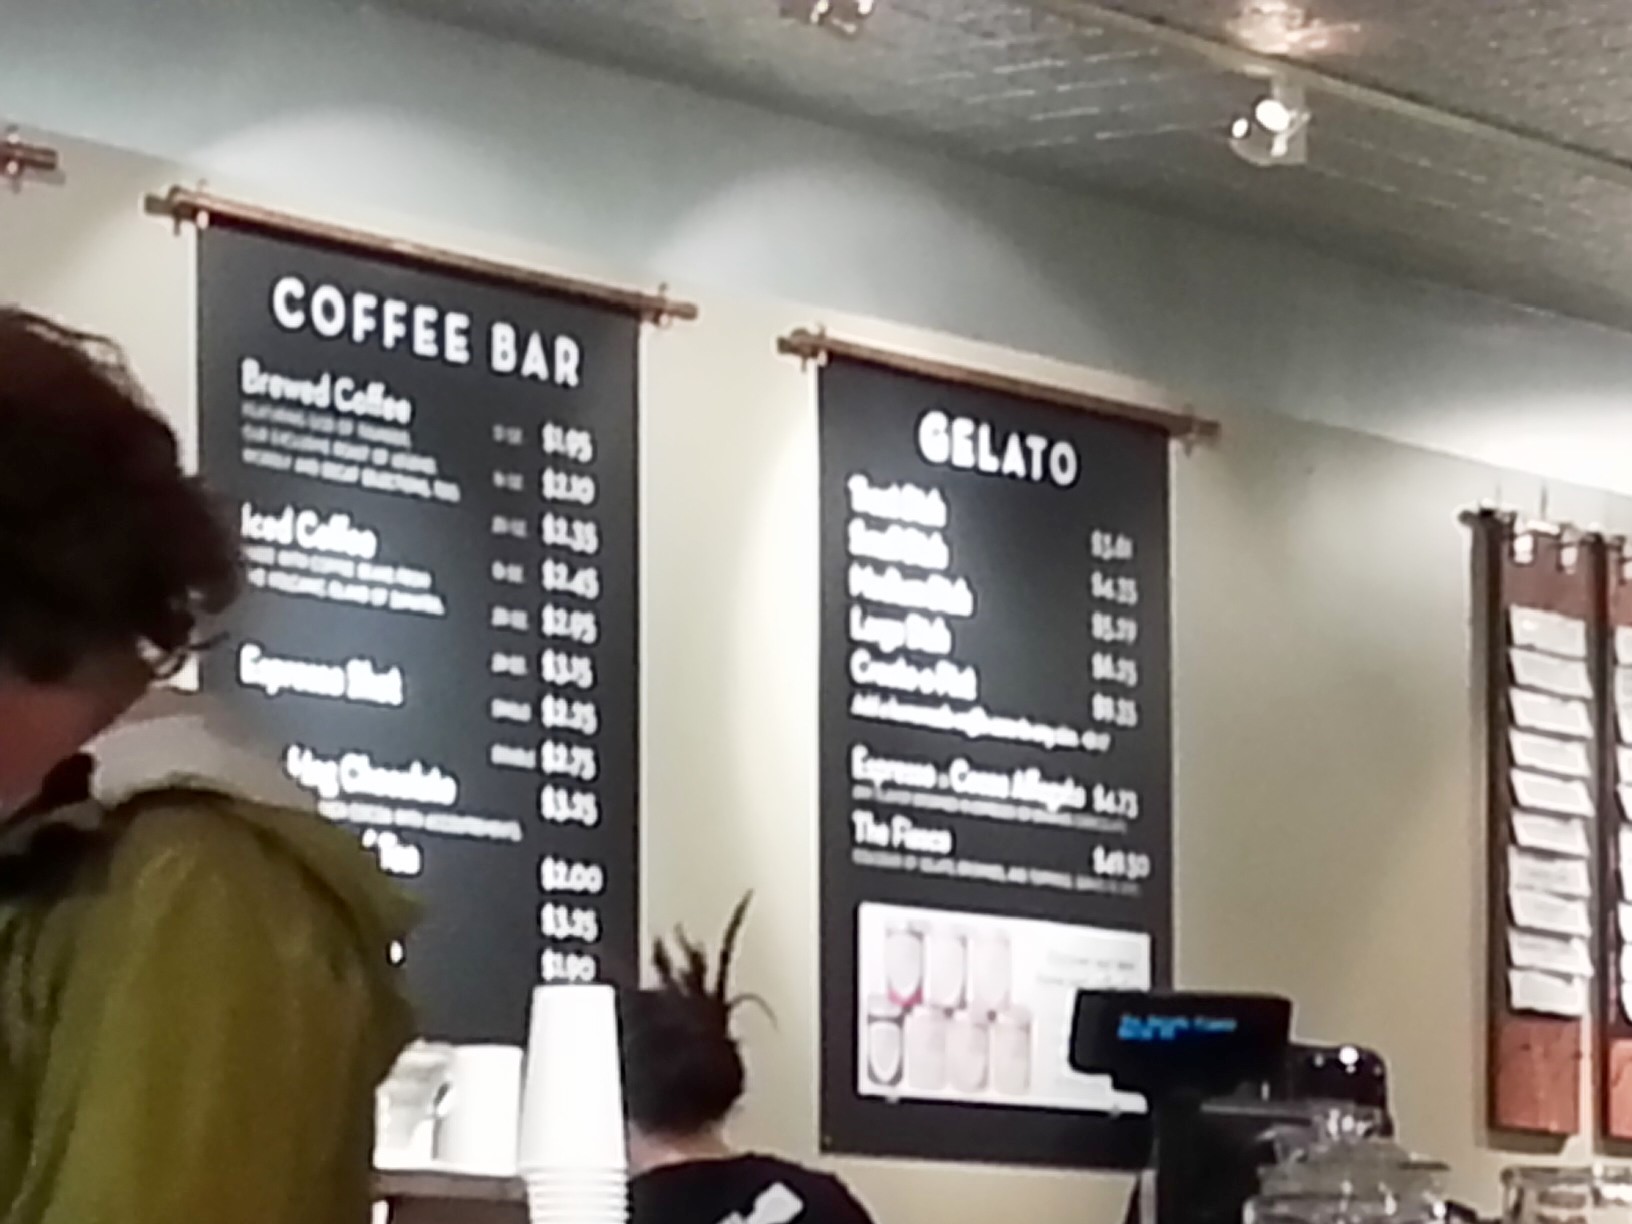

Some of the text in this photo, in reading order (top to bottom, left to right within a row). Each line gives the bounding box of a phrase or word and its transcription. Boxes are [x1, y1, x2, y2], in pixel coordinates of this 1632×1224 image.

[274, 277, 579, 386] COFFEE BAR
[334, 377, 411, 423] Coffee
[919, 411, 1076, 484] GELATO
